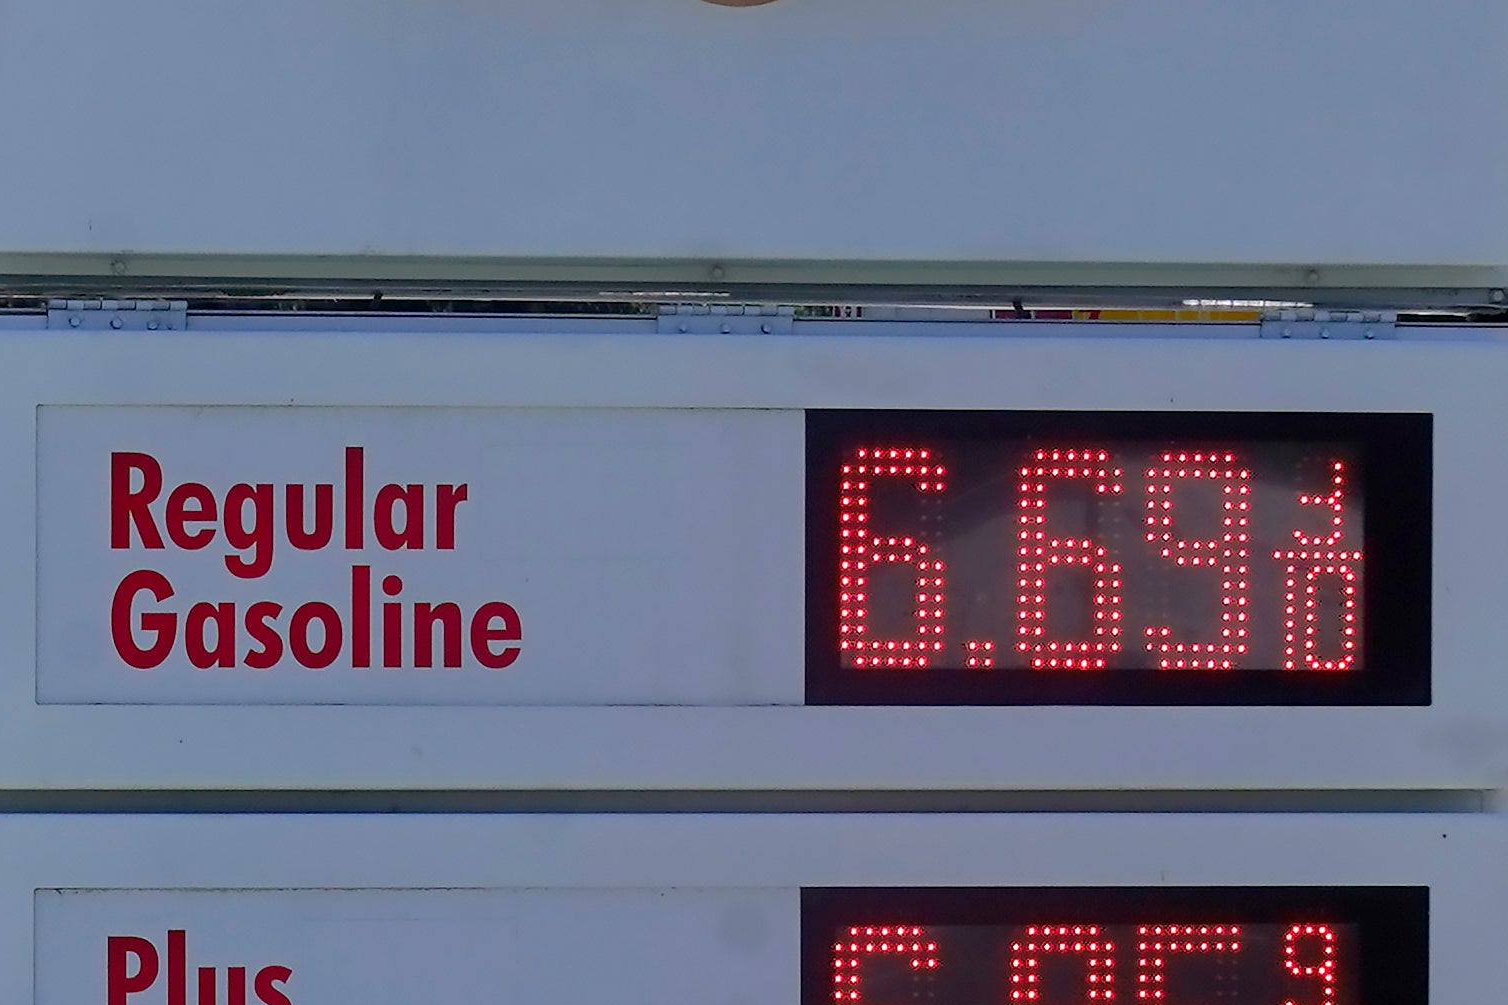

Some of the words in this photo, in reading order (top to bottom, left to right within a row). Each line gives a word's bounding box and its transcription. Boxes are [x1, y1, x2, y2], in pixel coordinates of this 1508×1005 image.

[111, 446, 468, 579] Regular
[839, 448, 1251, 670] 6.69
[110, 565, 523, 669] Gasoline
